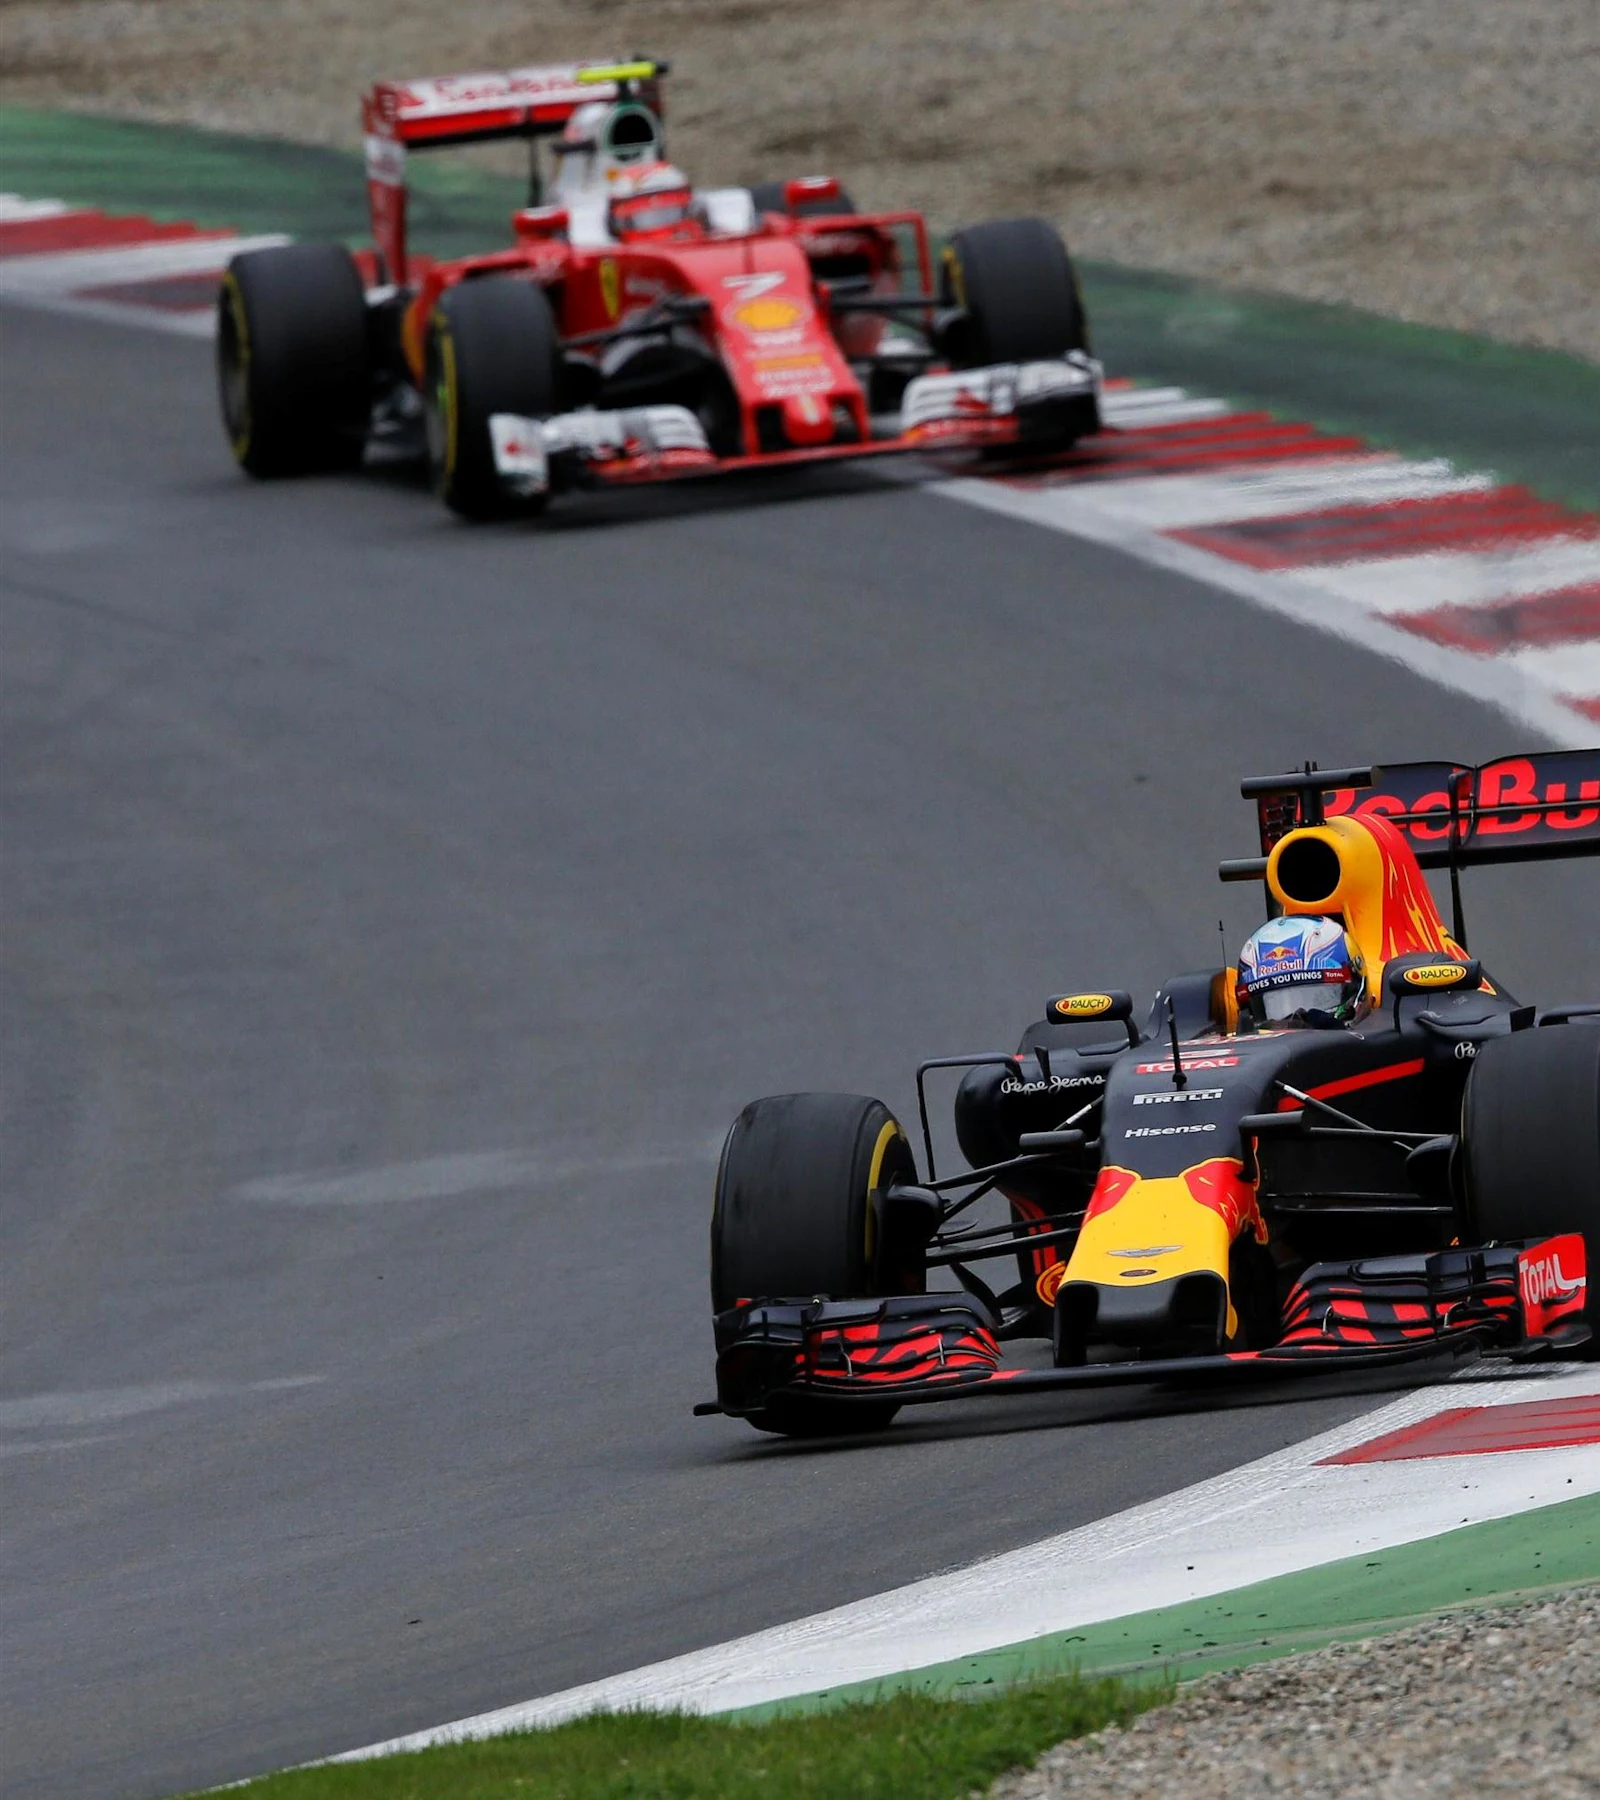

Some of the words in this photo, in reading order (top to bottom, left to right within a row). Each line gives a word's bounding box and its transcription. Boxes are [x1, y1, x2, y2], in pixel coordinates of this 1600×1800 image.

[1259, 961, 1281, 976] Red
[1280, 958, 1303, 971] Bull
[1325, 970, 1344, 979] TOTAL
[1419, 967, 1459, 980] RAUCH
[1247, 978, 1270, 993] GIVES
[1271, 973, 1292, 985] YOU
[1292, 970, 1322, 981] WINGS
[1069, 997, 1105, 1010] RAUCH
[1454, 1041, 1482, 1060] Pe
[1138, 1057, 1237, 1073] TOTAL
[1000, 1077, 1048, 1096] Pepe
[1048, 1074, 1106, 1095] Jeans
[1133, 1088, 1224, 1106] PIRELLI
[1125, 1122, 1217, 1139] Hisense
[1518, 1252, 1587, 1307] TOTAL
